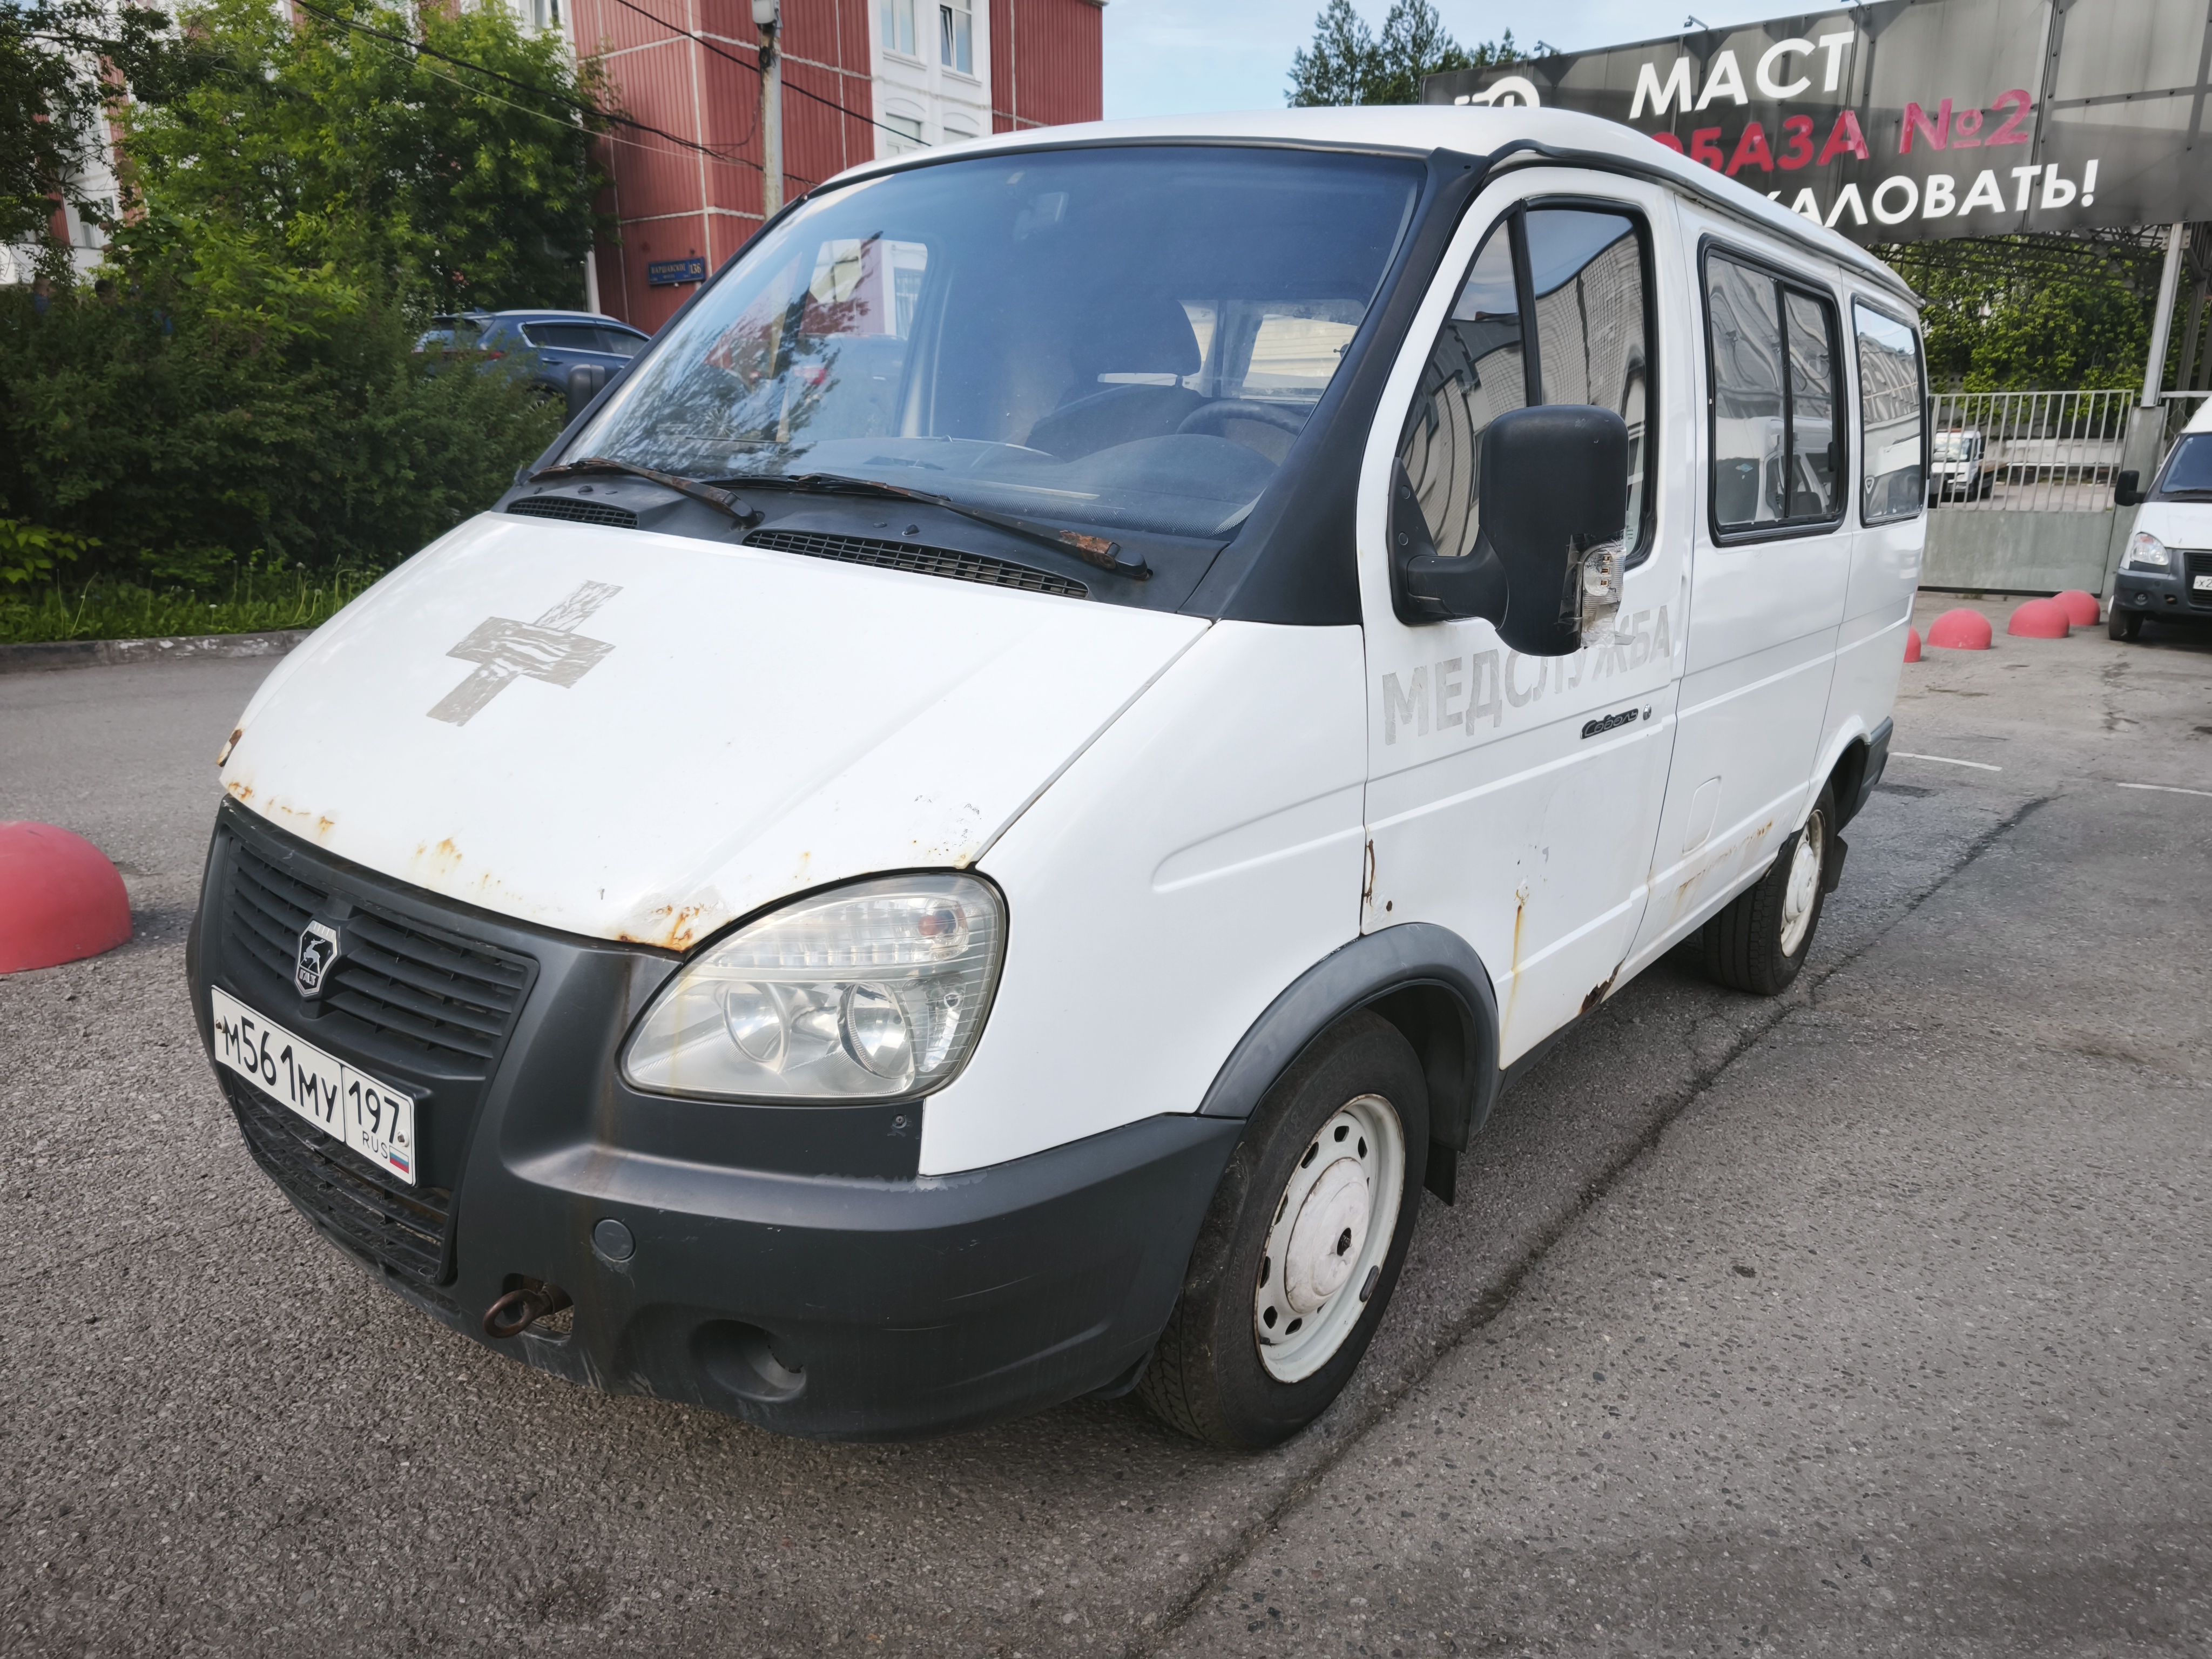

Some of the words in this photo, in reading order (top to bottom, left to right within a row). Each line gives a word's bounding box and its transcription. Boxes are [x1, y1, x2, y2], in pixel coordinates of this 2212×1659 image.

[1629, 31, 1854, 120] МАСТ
[1899, 89, 2032, 154] №2
[1766, 159, 2099, 228] АЛОВАТЬ!
[299, 969, 316, 986] ГАЗ
[348, 1080, 400, 1144] 197
[362, 1131, 388, 1160] RUS
